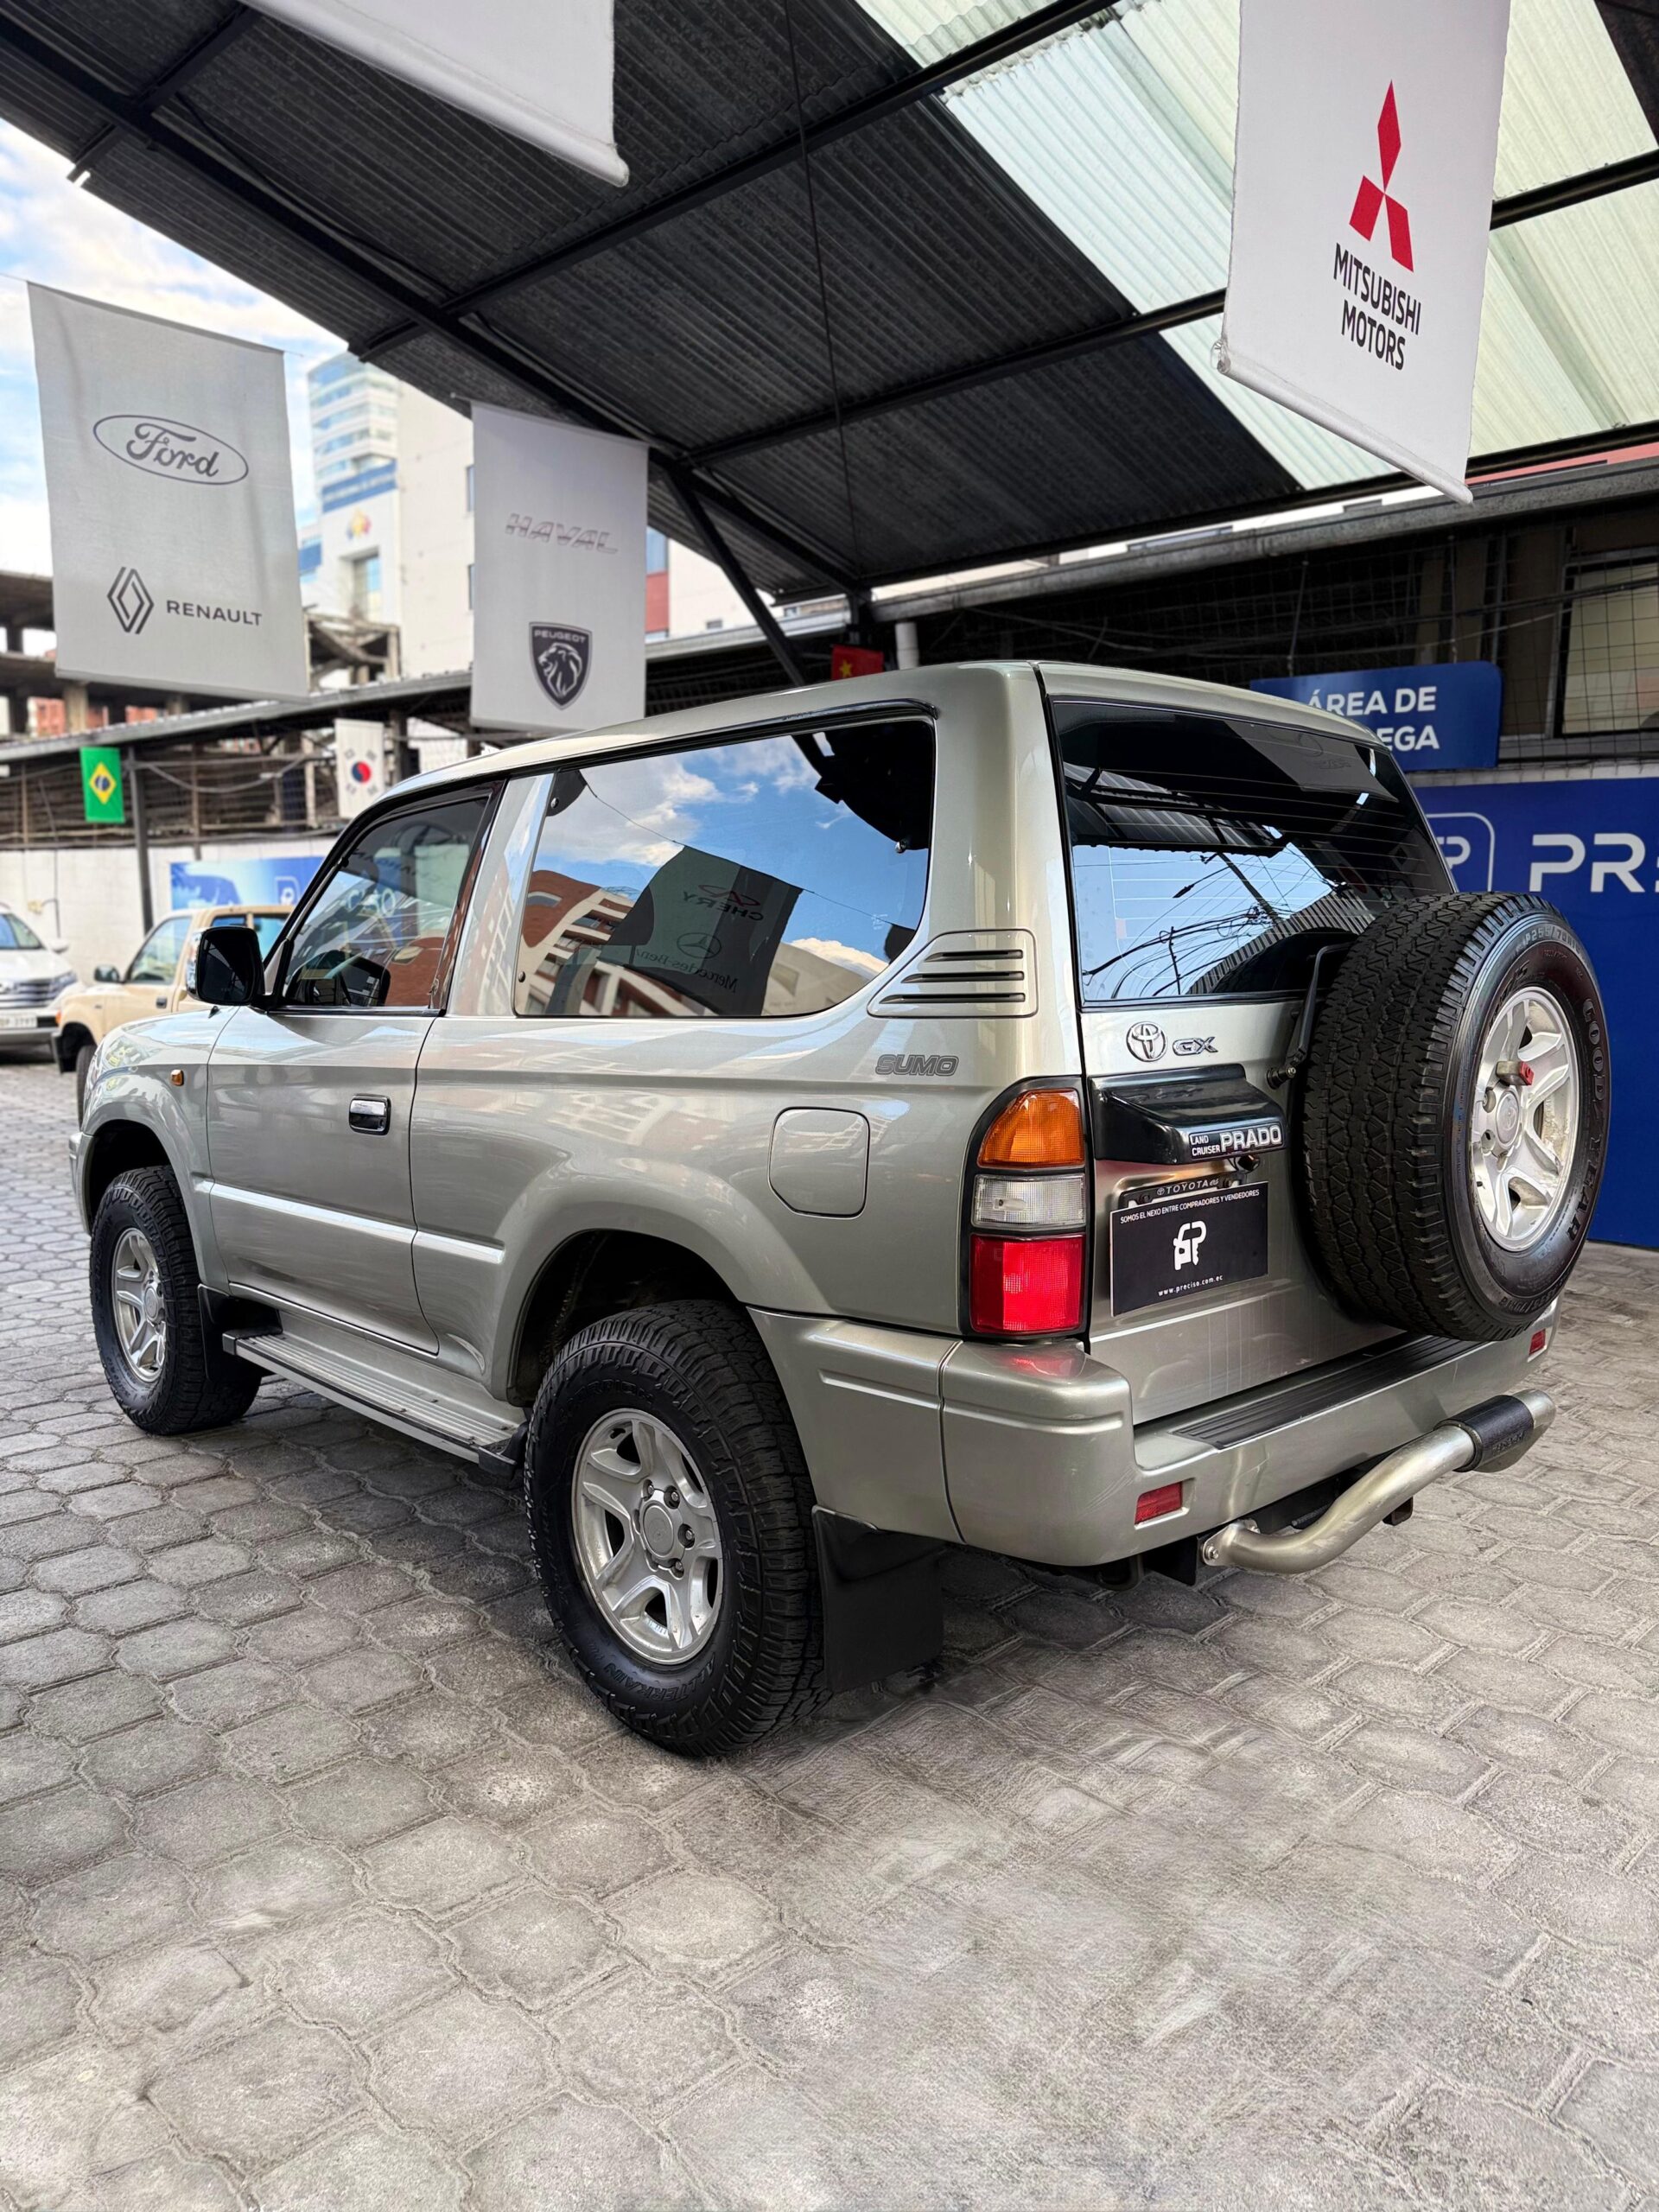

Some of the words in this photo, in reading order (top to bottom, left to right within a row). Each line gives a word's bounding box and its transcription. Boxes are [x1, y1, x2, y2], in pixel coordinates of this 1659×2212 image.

[1333, 243, 1421, 335] MITSUBISHI
[1341, 299, 1405, 370] MOTORS
[126, 422, 219, 479] Ford
[505, 512, 618, 555] HAVAL
[166, 600, 262, 626] RENAULT
[534, 629, 587, 644] PEUGEOT
[1308, 689, 1389, 716] ÁREA
[1395, 686, 1437, 713] DE
[1376, 725, 1440, 752] EGA
[1529, 832, 1659, 893] PR
[1172, 1036, 1219, 1056] GX
[875, 1054, 959, 1077] SUMO
[1191, 1134, 1209, 1146] LAND
[1192, 1144, 1220, 1157] CRUISER
[1220, 1125, 1282, 1153] PRADO
[1166, 1179, 1209, 1194] TOYOTA
[1120, 1212, 1139, 1224] SOMOS
[1147, 1208, 1161, 1217] NEXO
[1161, 1204, 1179, 1214] ENTRE
[1179, 1197, 1220, 1211] COMPRADORES
[1224, 1189, 1260, 1202] VENDEDORES
[1158, 1274, 1224, 1297] www.preciso.com.ec
